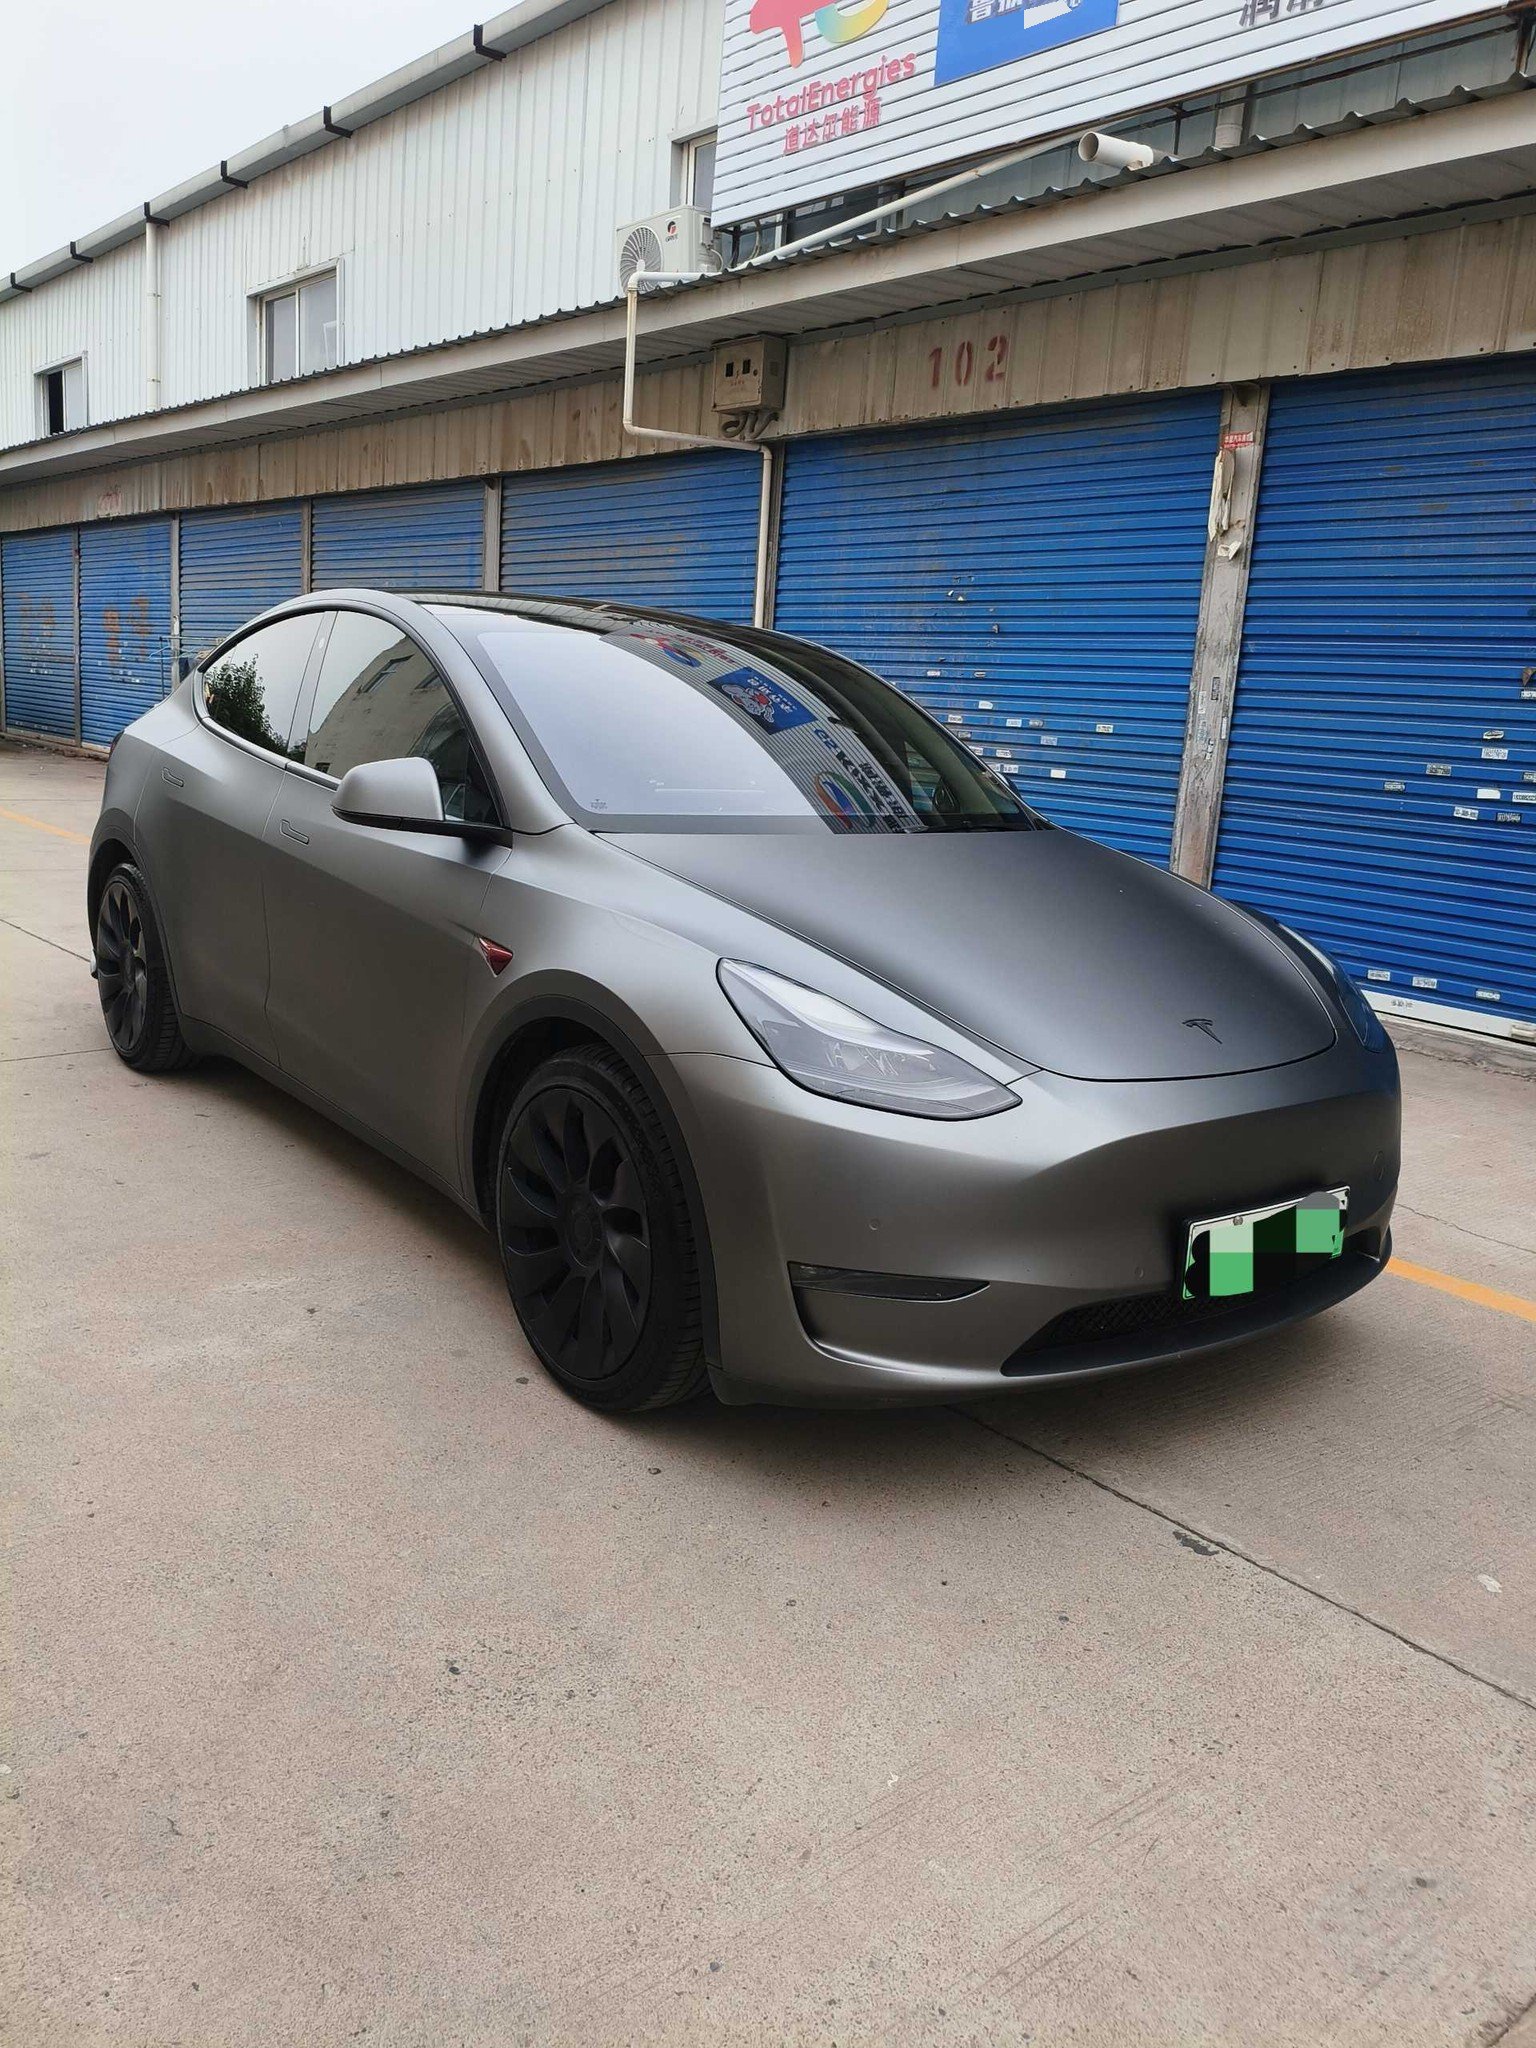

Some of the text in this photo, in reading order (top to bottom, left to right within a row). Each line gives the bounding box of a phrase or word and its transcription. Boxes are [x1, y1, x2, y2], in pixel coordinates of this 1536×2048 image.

[747, 52, 917, 130] TotalEnergies
[784, 98, 881, 155] 道达尔能源
[929, 334, 1007, 388] 102
